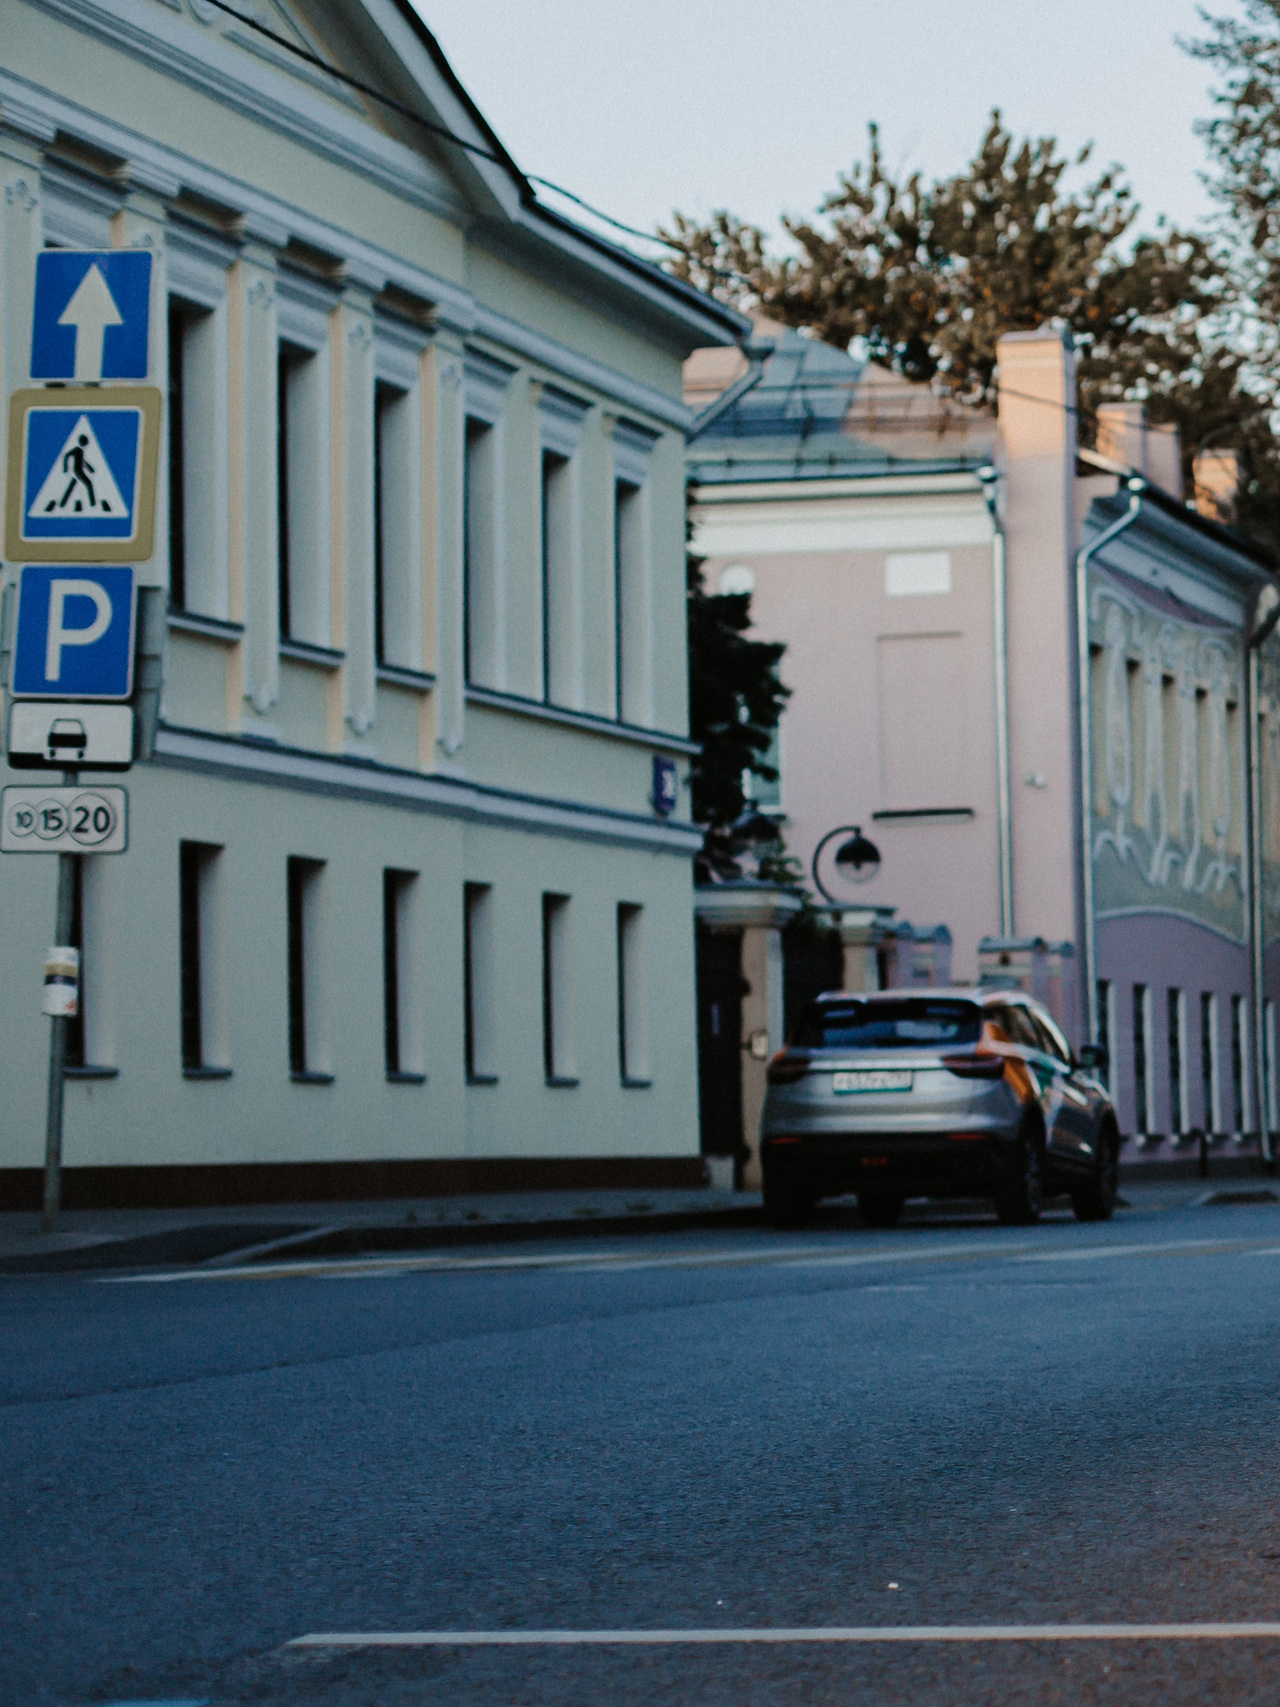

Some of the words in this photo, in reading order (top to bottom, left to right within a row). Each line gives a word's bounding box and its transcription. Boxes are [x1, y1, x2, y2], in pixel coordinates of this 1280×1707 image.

[45, 579, 113, 682] P
[15, 810, 34, 828] 10
[40, 808, 64, 831] 15
[72, 806, 110, 833] 20
